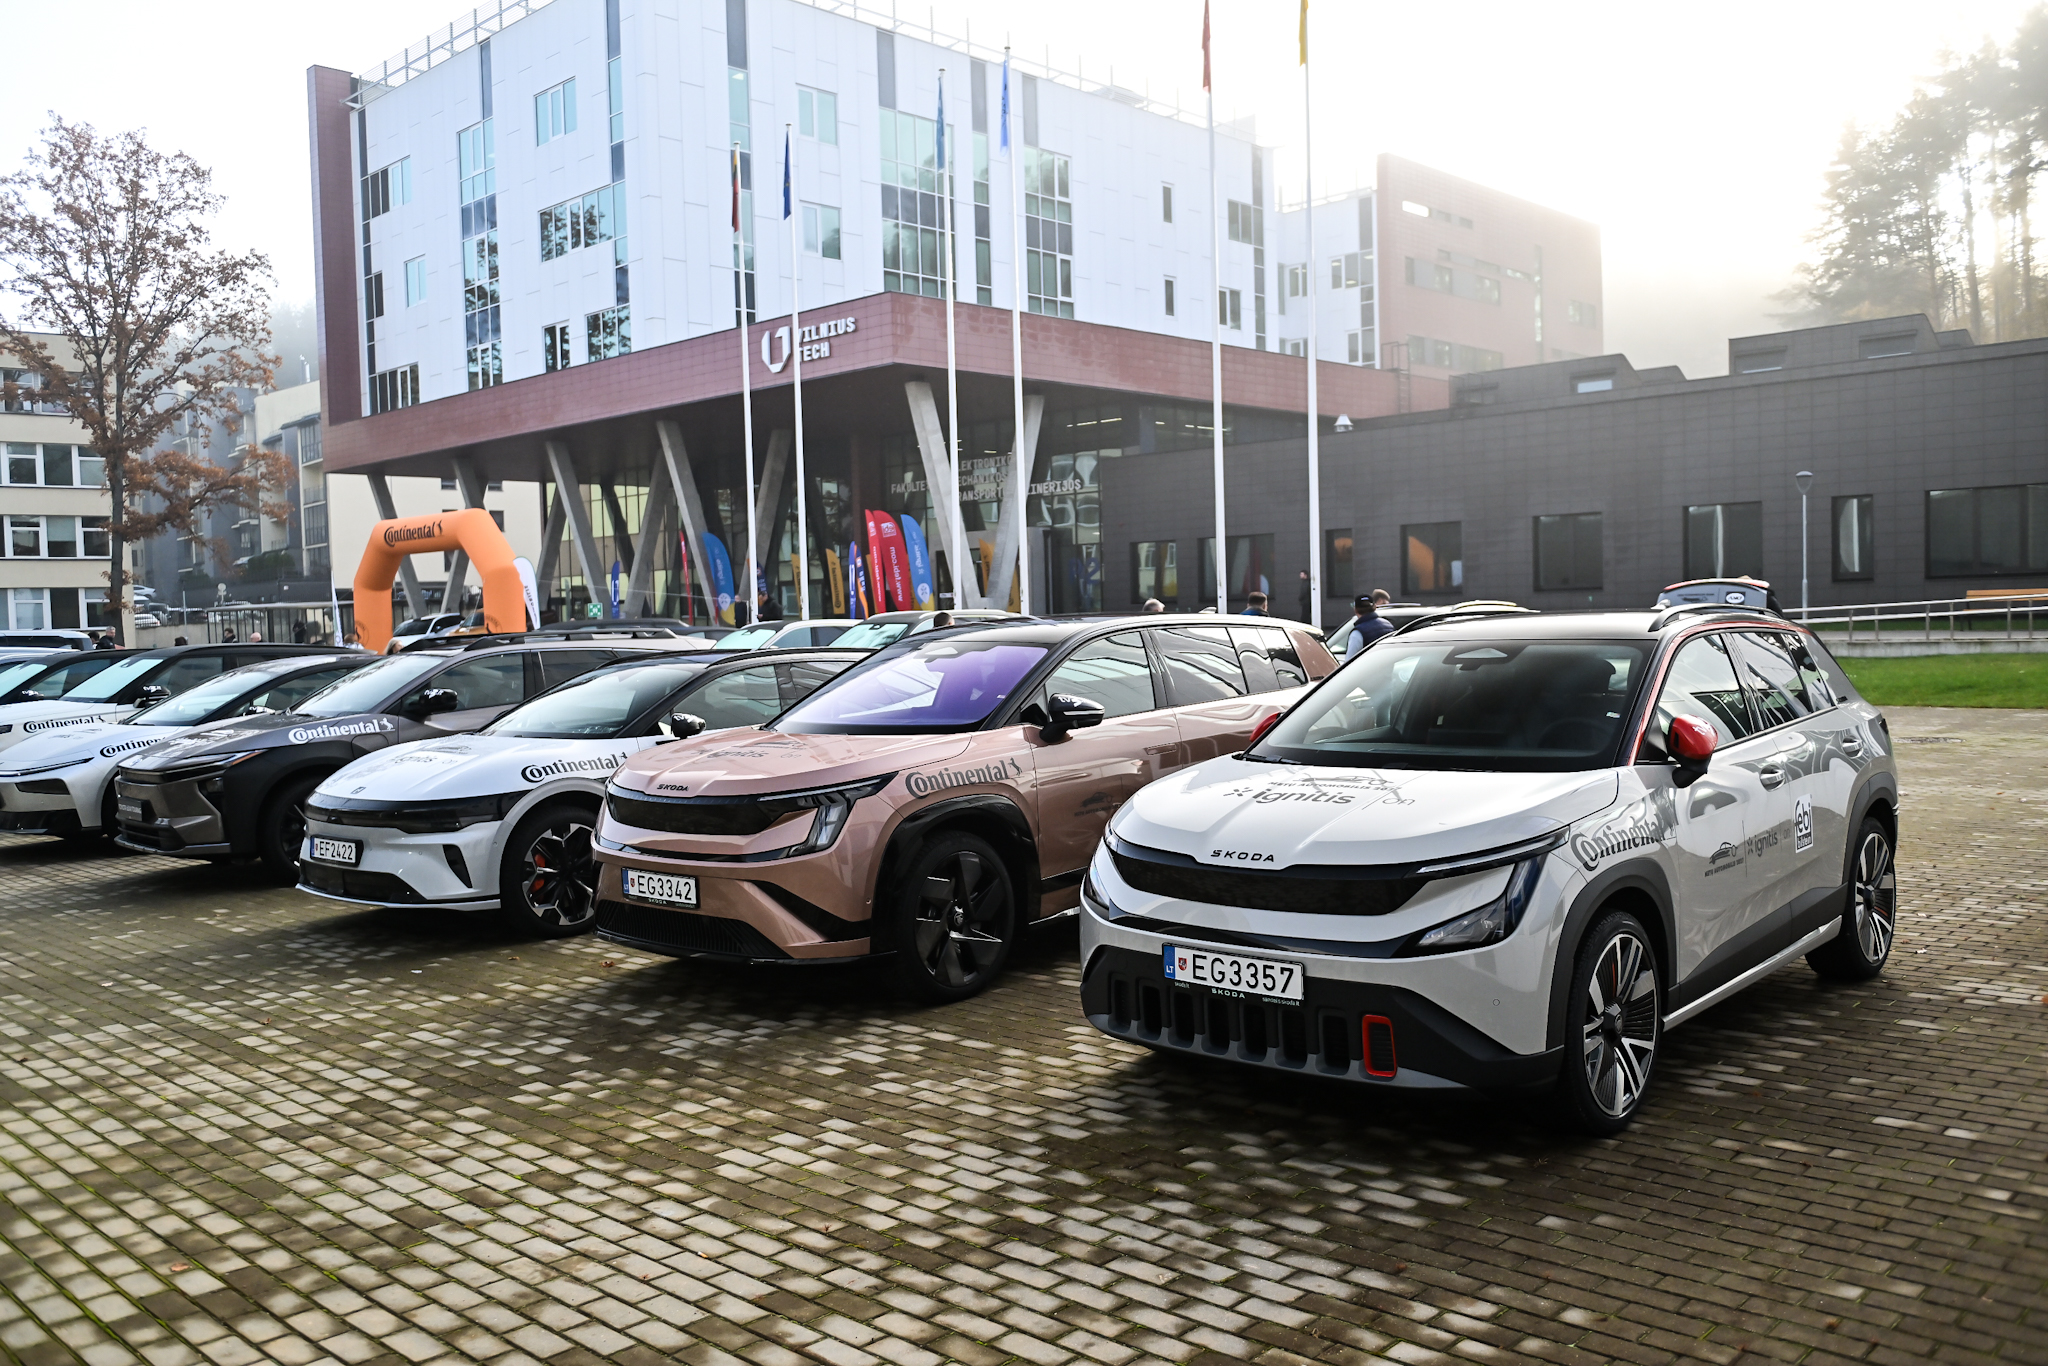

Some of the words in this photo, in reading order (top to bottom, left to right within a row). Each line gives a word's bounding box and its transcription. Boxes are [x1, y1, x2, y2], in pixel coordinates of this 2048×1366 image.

[798, 317, 856, 344] VILNIUS
[958, 455, 1012, 471] EKTRONIKO
[891, 480, 928, 494] FAKULTE
[958, 471, 1009, 487] ECHANIKOS
[958, 486, 1004, 502] RANSPORT
[1028, 479, 1082, 495] INERIJOS
[384, 521, 436, 547] Continental
[23, 716, 95, 733] Continental
[288, 719, 381, 744] Continental
[521, 754, 619, 783] Continental
[905, 760, 1009, 799] Continental
[1252, 788, 1356, 804] ignitis
[319, 841, 353, 860] EF2422
[1570, 812, 1665, 871] Continental
[1755, 829, 1778, 857] ignitis
[638, 875, 692, 900] EG3342
[1166, 965, 1174, 973] LT
[1193, 953, 1294, 993] EG3357
